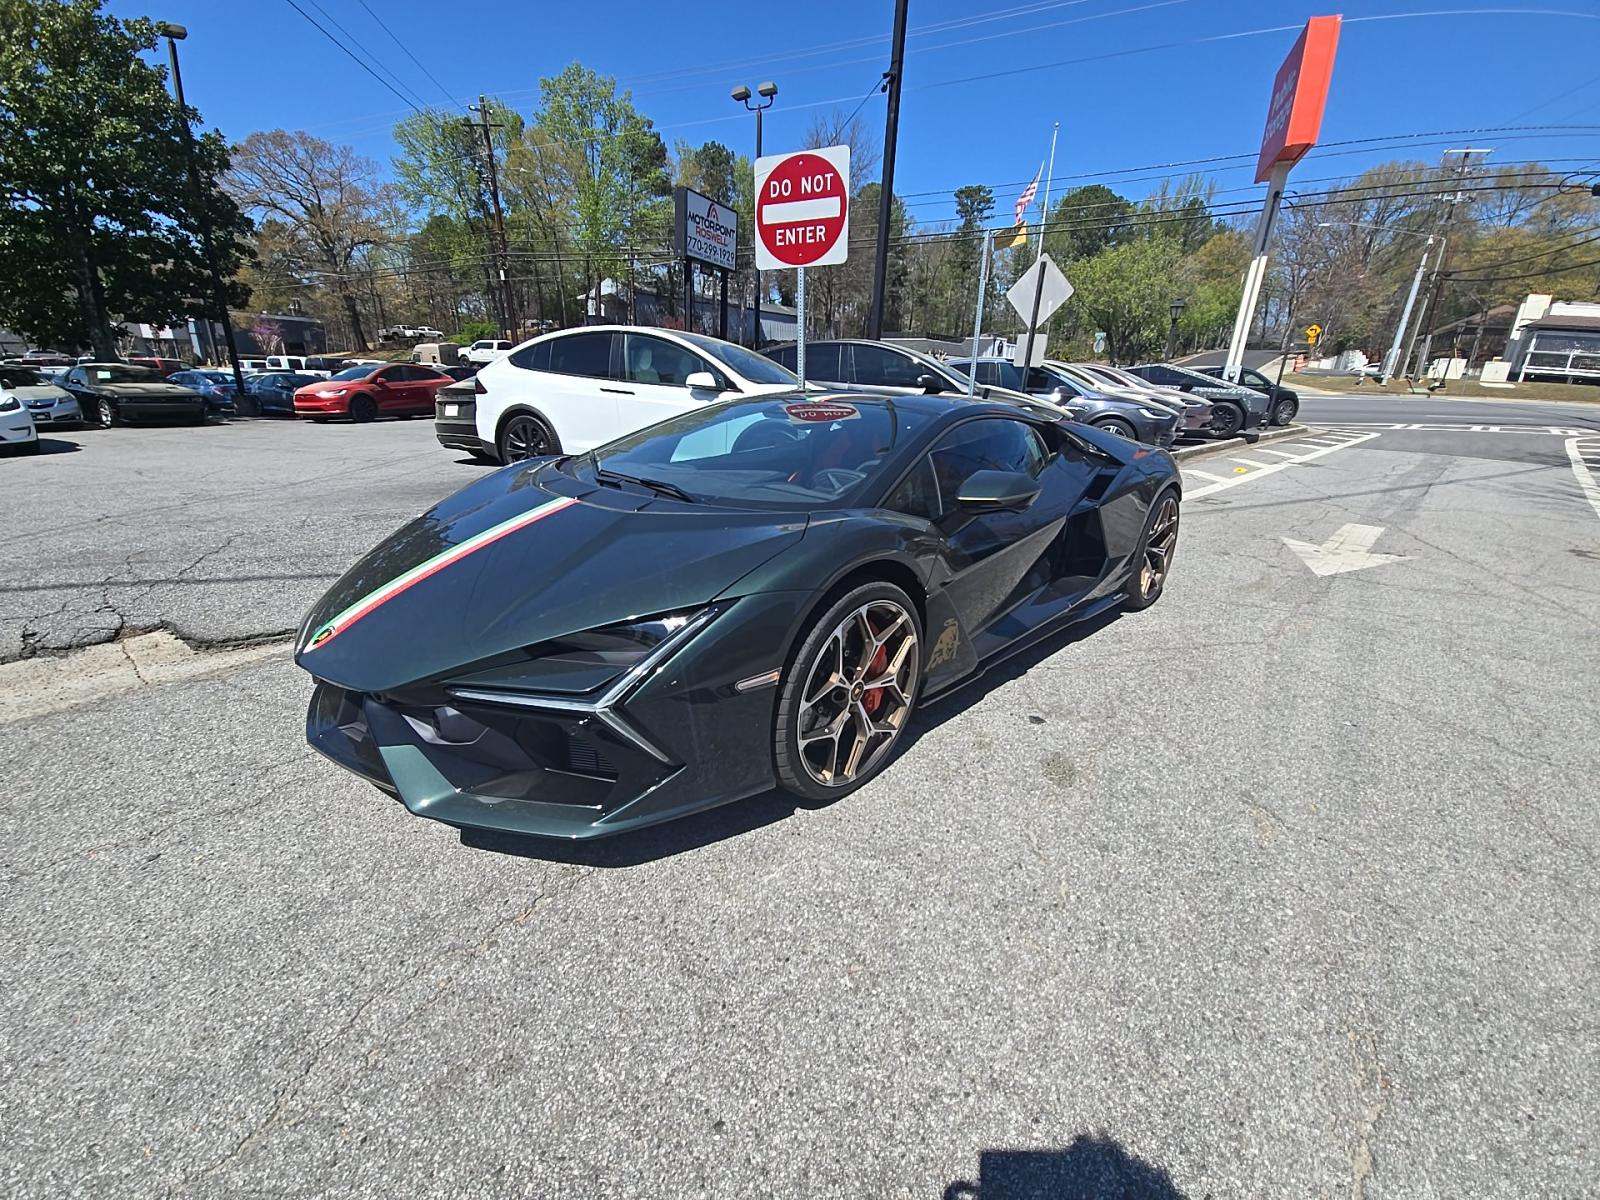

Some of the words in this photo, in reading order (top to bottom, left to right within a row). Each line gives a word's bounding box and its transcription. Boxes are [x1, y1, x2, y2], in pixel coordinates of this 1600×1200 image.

[770, 179, 791, 198] DO
[801, 172, 833, 195] NOT
[688, 211, 735, 238] MOTORPOINT
[695, 225, 729, 247] ROSWELL
[776, 225, 826, 247] ENTER
